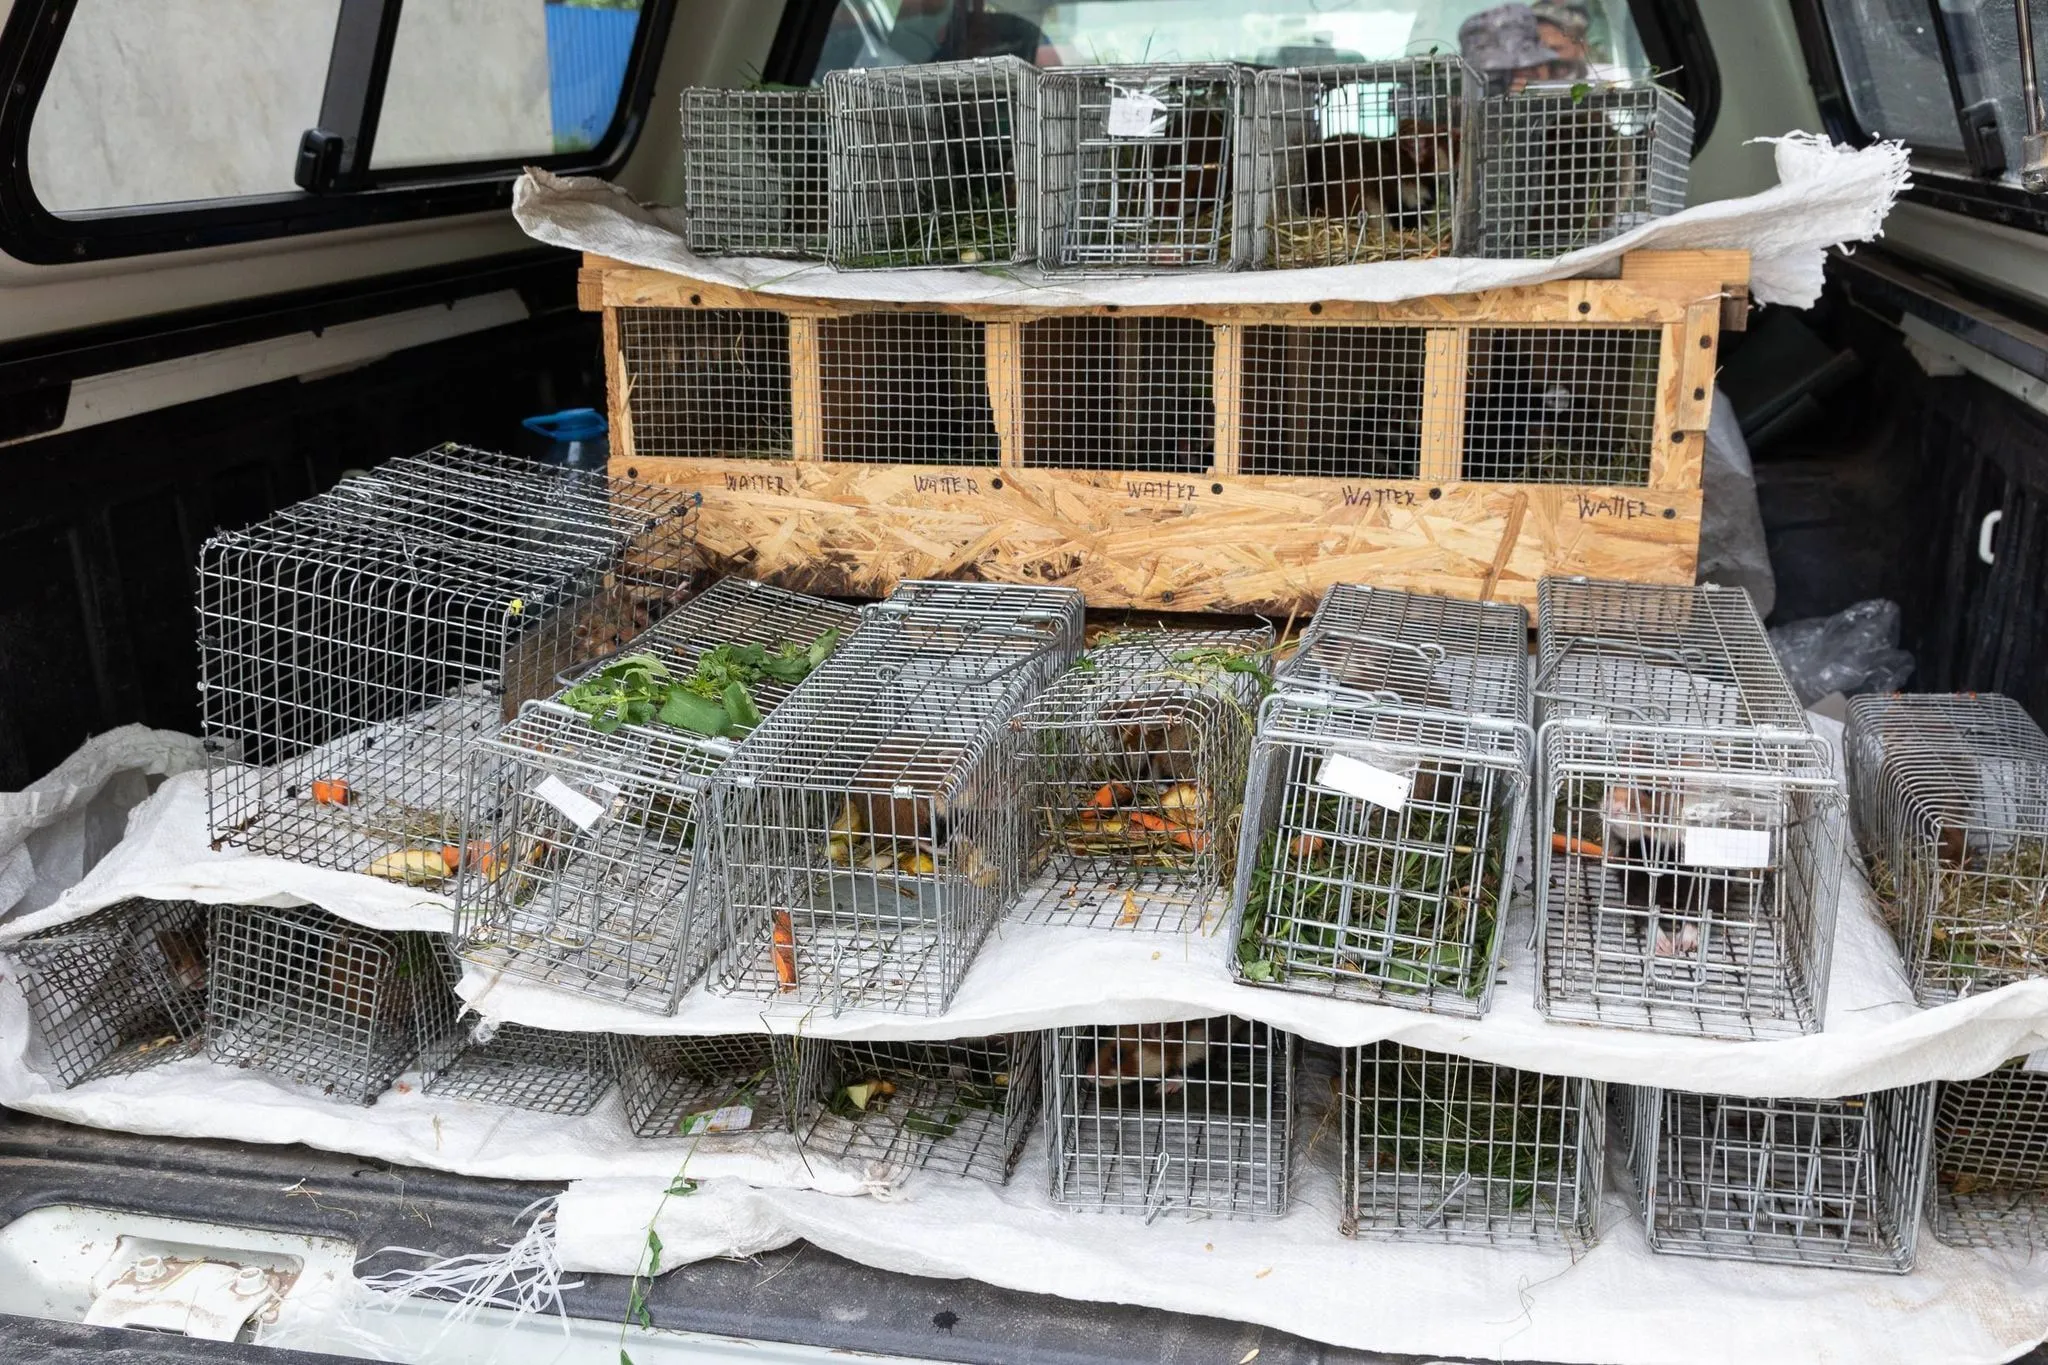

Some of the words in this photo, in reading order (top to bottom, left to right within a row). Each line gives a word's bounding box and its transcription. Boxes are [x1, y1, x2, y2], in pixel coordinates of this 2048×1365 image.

[724, 472, 789, 495] WATTER
[913, 475, 980, 495] WATTER
[1127, 480, 1199, 500] WATTER
[1342, 485, 1417, 508] WATTER
[1577, 493, 1656, 520] WATTER
